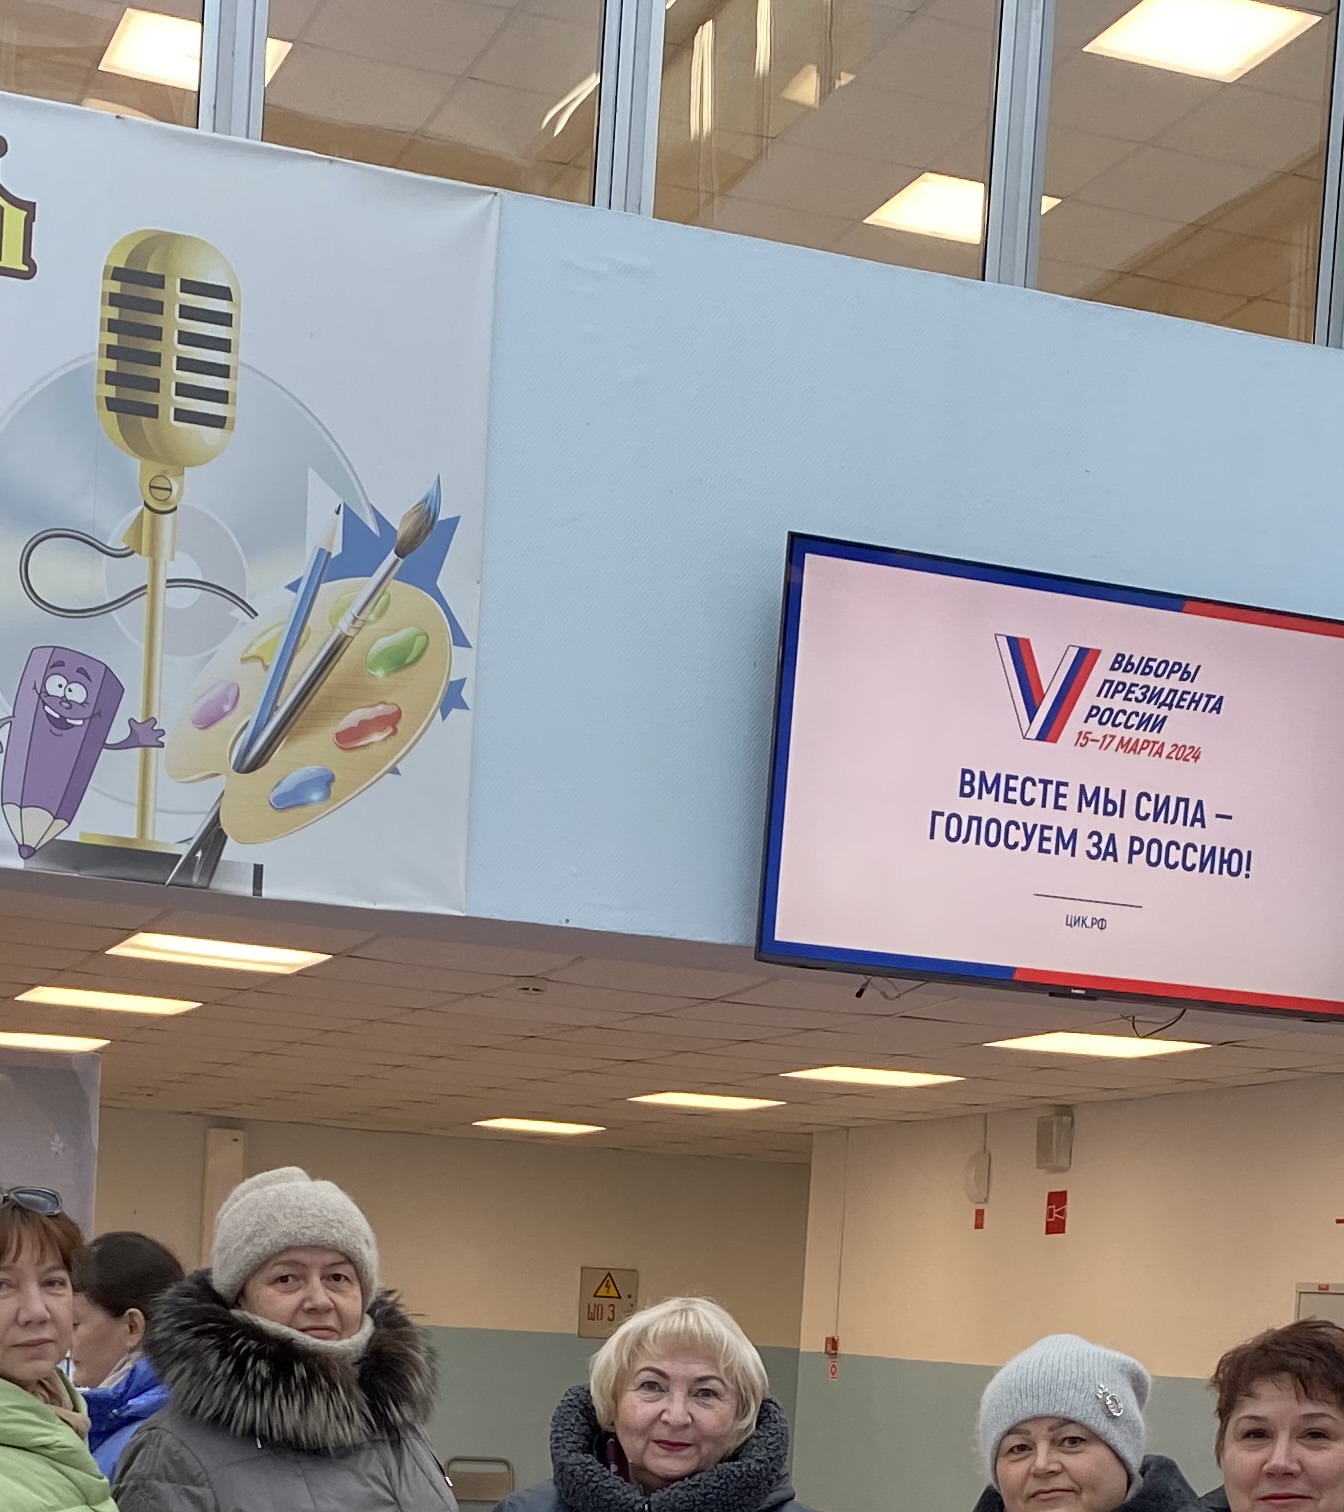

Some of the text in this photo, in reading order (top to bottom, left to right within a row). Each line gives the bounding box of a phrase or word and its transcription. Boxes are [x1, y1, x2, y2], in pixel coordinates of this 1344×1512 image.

[1109, 652, 1202, 684] ВЫБОРЫ
[1096, 678, 1225, 715] ПРЕЗИДЕНТА
[1083, 705, 1168, 734] РОССИИ
[1114, 736, 1166, 759] МАРТА
[1165, 743, 1202, 764] 2024
[958, 767, 1069, 811] ВМЕСТЕ
[1076, 783, 1127, 819] МЫ
[1134, 791, 1207, 829] СИЛА
[928, 809, 1253, 879] ГОЛОСУЕМ ЗА РОССИЮ!
[1064, 913, 1107, 931] ЦИК.РФ
[607, 1303, 616, 1322] 3
